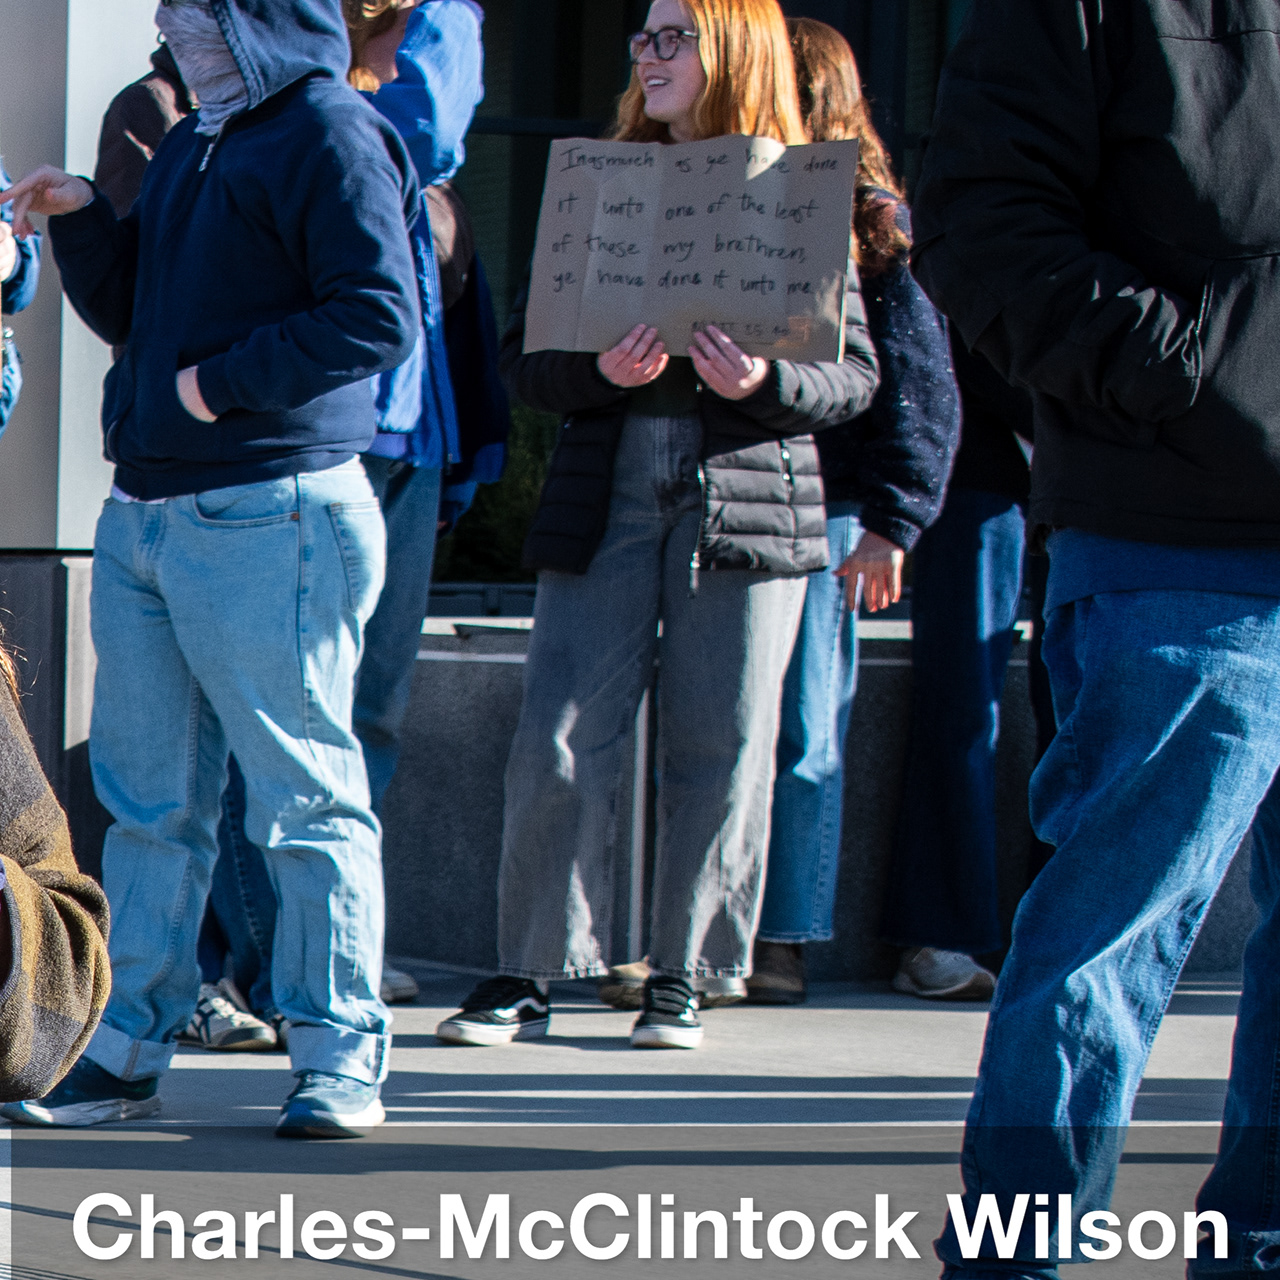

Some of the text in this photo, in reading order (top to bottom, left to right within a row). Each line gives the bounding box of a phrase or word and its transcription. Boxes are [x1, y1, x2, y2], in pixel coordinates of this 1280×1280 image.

[675, 156, 692, 173] as
[706, 153, 732, 175] ye
[665, 205, 696, 221] one
[707, 193, 732, 214] of
[738, 193, 765, 215] the
[774, 199, 820, 223] least
[552, 233, 574, 254] of
[663, 240, 695, 262] my
[553, 271, 577, 293] ye
[597, 268, 644, 287] have
[658, 270, 702, 288] done
